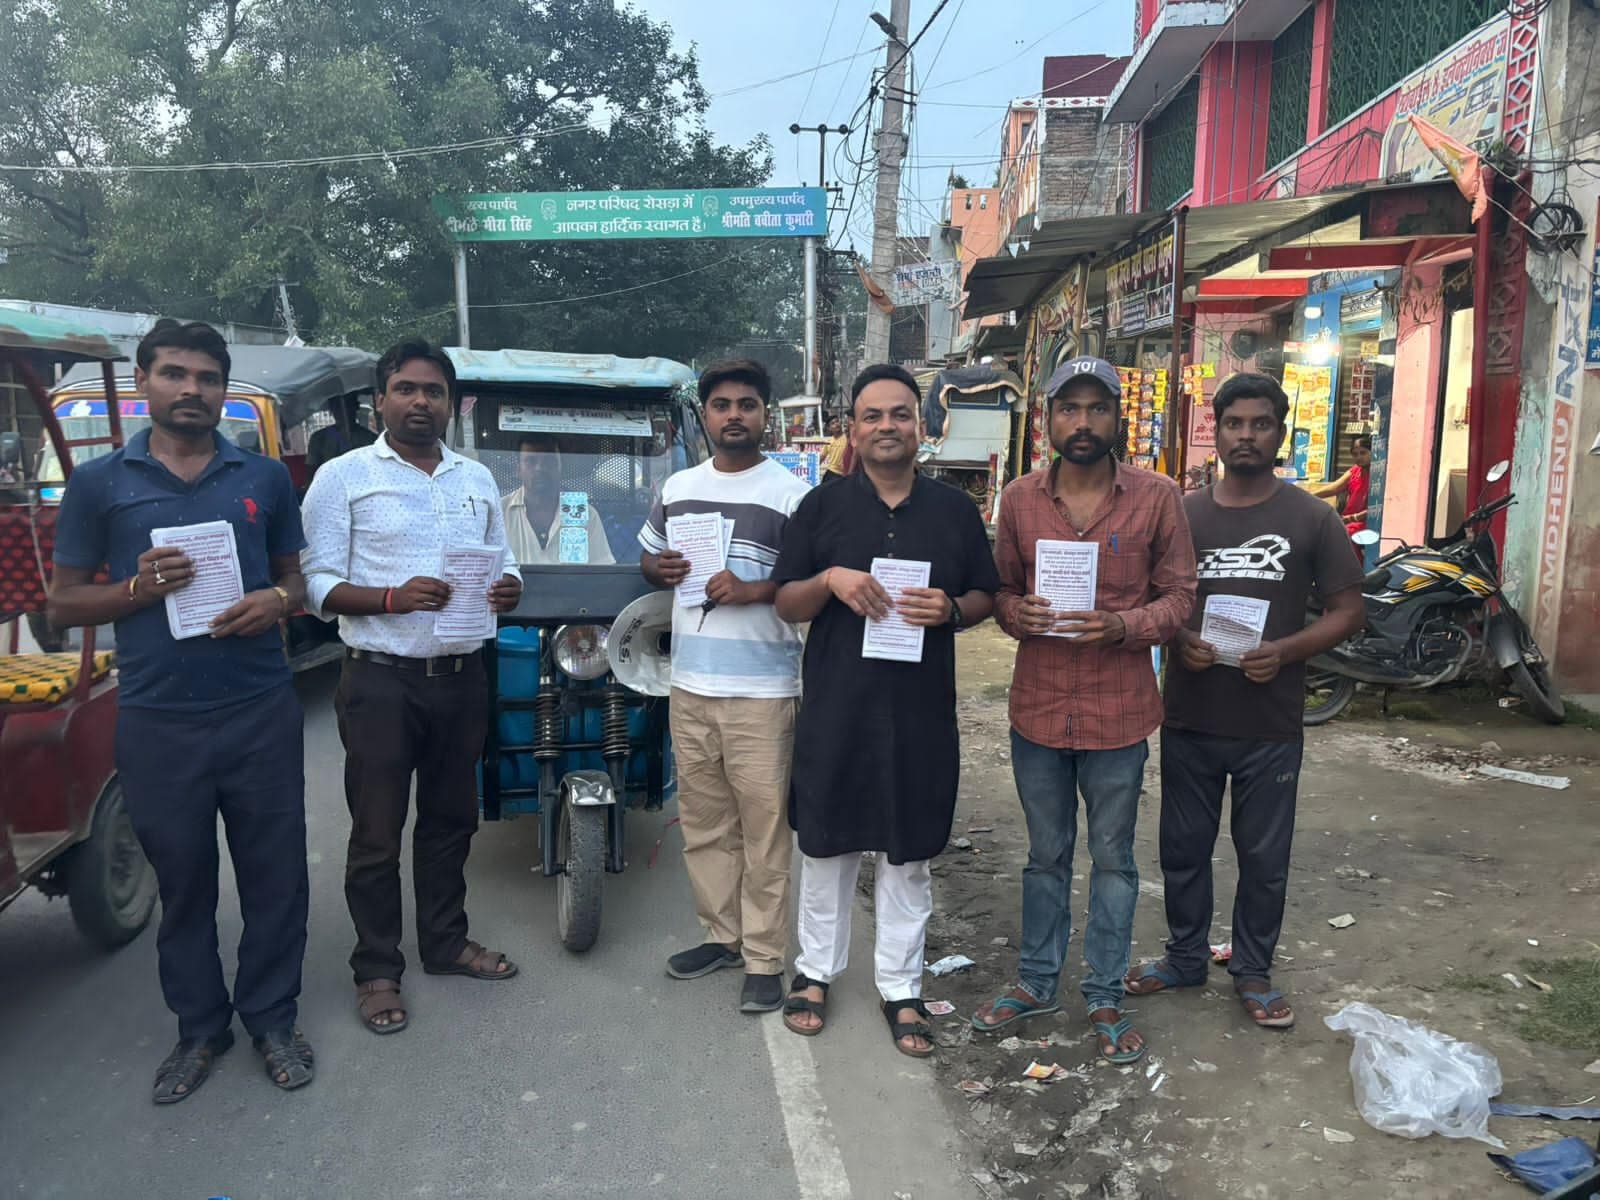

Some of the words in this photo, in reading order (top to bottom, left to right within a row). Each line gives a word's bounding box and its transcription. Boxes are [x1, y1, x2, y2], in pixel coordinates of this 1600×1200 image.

[566, 199, 597, 211] नगर
[599, 195, 641, 211] परिषद
[682, 193, 695, 209] में
[729, 195, 774, 209] उपमुख्य
[510, 214, 533, 232] सिंह
[552, 220, 598, 233] आपका
[600, 217, 642, 233] हार्दिक
[645, 218, 689, 232] स्वागत
[784, 209, 814, 231] कुमारी
